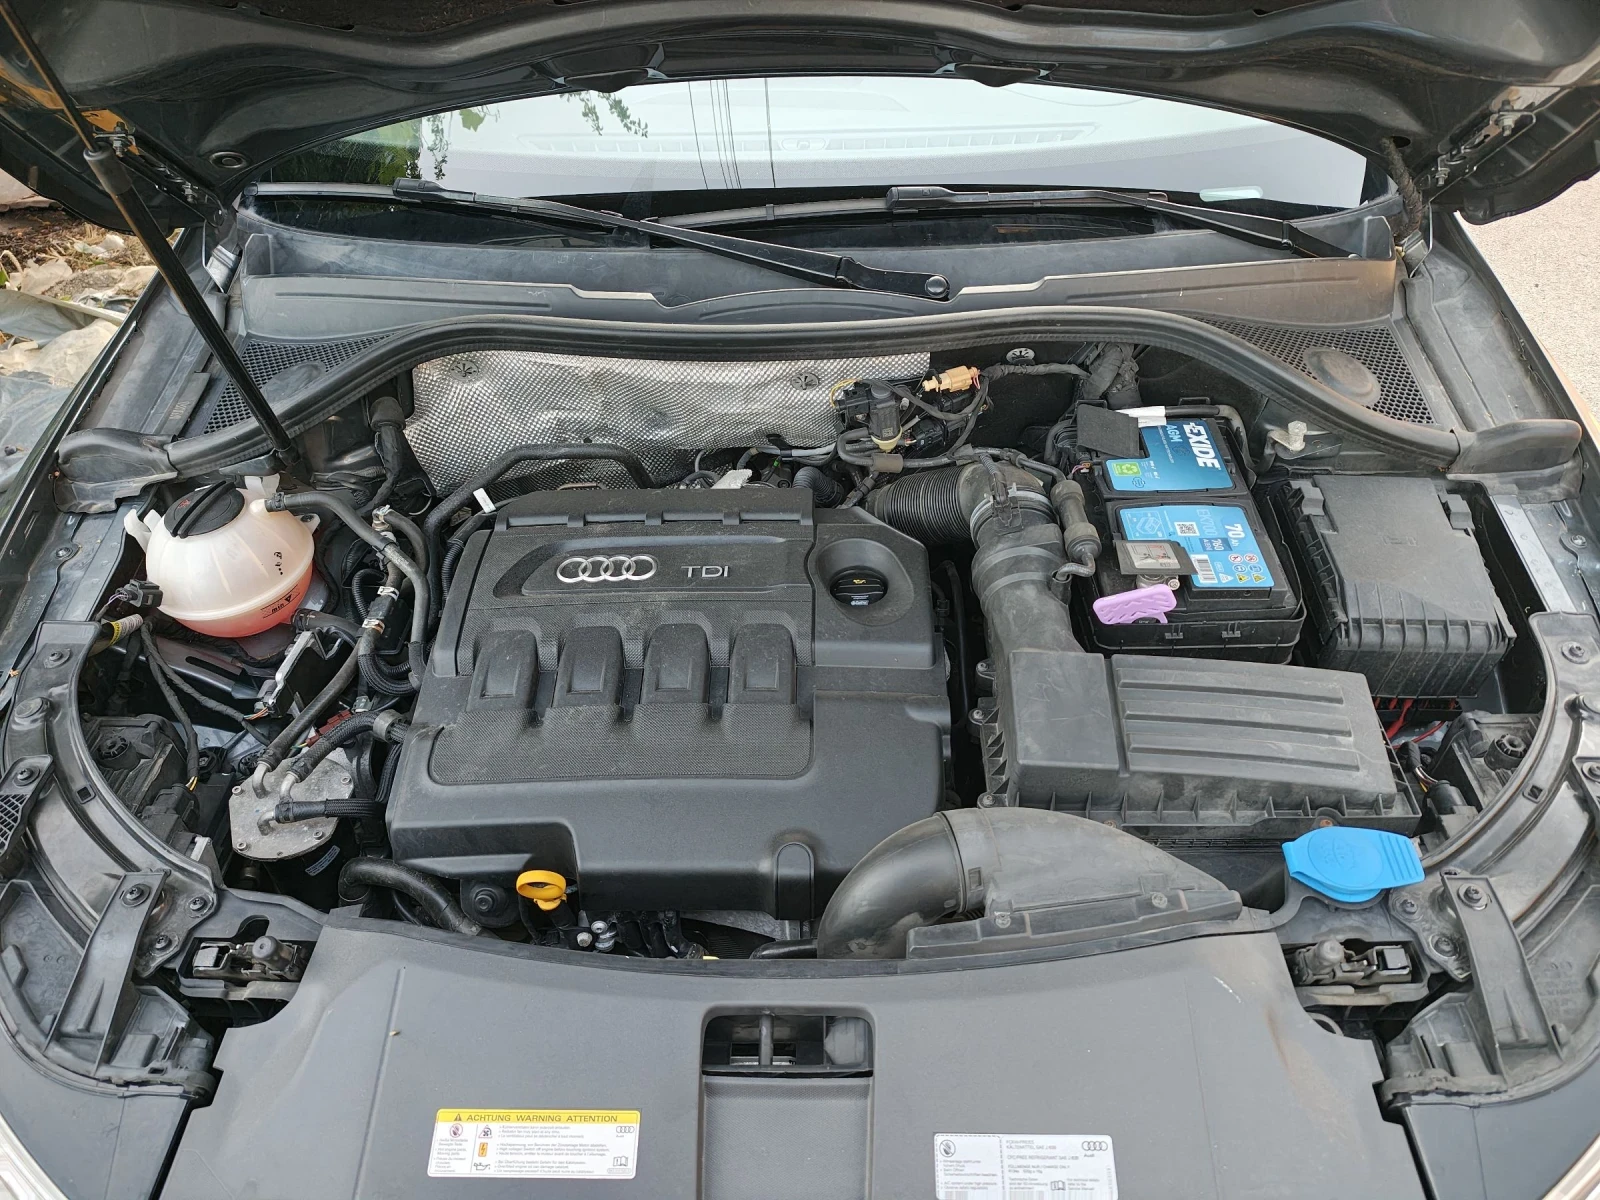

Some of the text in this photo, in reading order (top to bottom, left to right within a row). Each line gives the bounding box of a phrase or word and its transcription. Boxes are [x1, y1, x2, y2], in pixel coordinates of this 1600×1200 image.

[1166, 425, 1183, 442] AGM
[1183, 422, 1221, 468] EXIDE
[1197, 509, 1218, 536] EK700
[1224, 523, 1245, 539] 70
[1211, 539, 1225, 551] 760
[681, 566, 729, 578] TDI
[467, 1114, 511, 1122] ACHTUNG
[516, 1114, 562, 1122] WARNING
